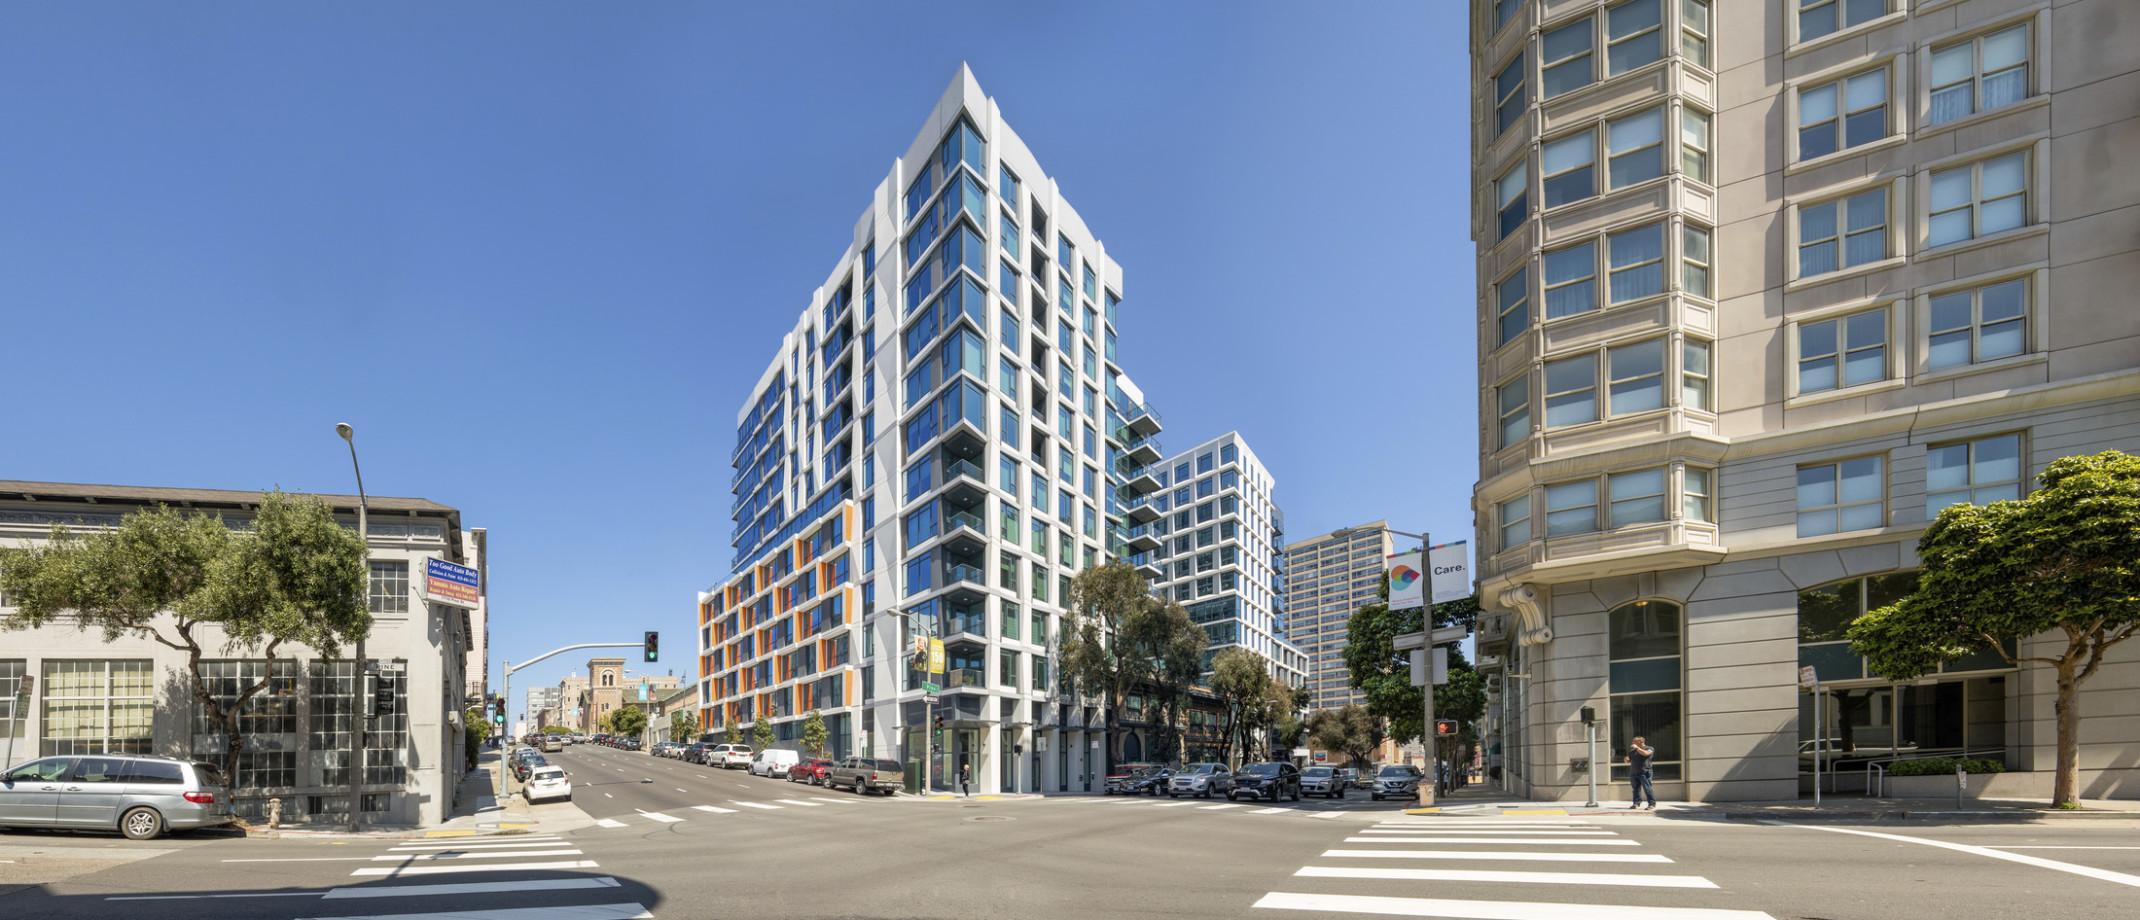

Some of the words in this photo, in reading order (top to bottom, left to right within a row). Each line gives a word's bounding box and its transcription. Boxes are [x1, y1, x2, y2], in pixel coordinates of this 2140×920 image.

[440, 563, 452, 571] Good
[465, 569, 477, 578] Body
[1434, 564, 1466, 576] Care.
[461, 586, 477, 595] Repair
[931, 652, 943, 663] 150
